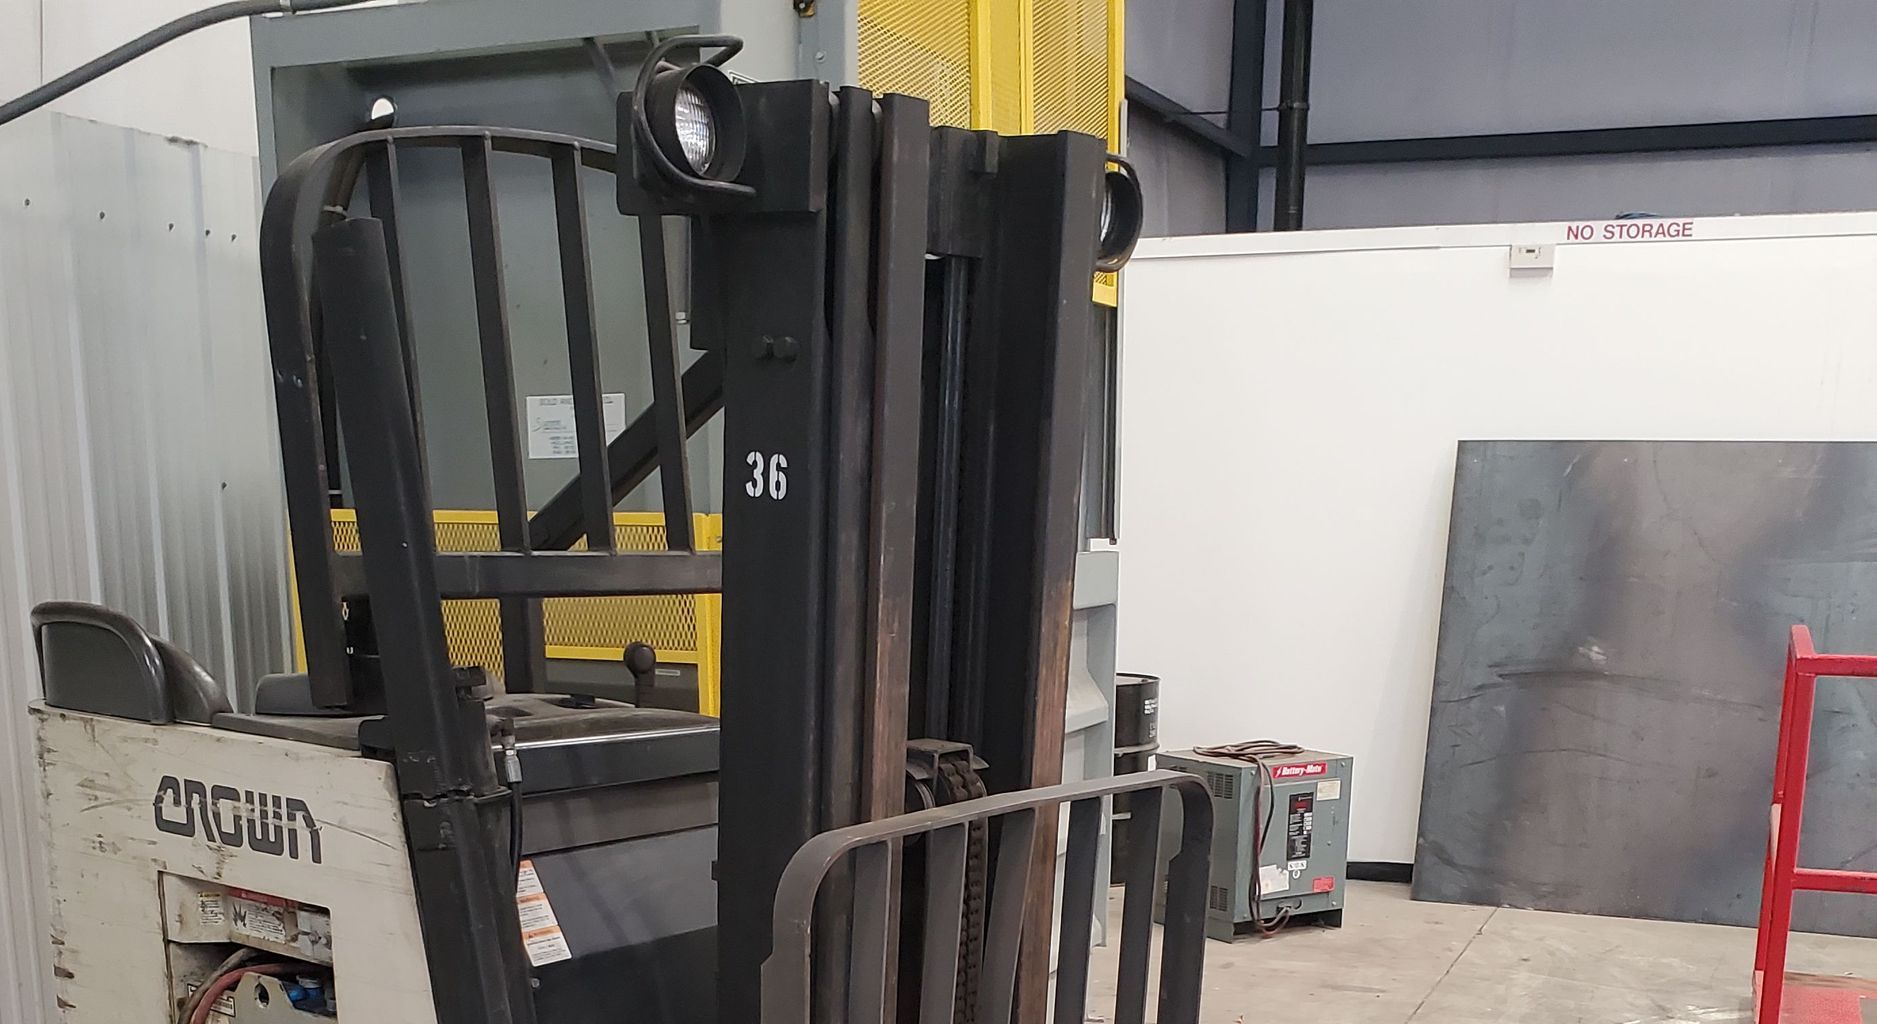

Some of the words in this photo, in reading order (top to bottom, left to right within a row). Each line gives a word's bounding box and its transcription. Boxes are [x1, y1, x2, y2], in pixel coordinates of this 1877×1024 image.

[1566, 224, 1595, 241] NO
[1602, 221, 1694, 240] STORAGE
[745, 451, 788, 500] 36
[153, 775, 322, 864] CROWN
